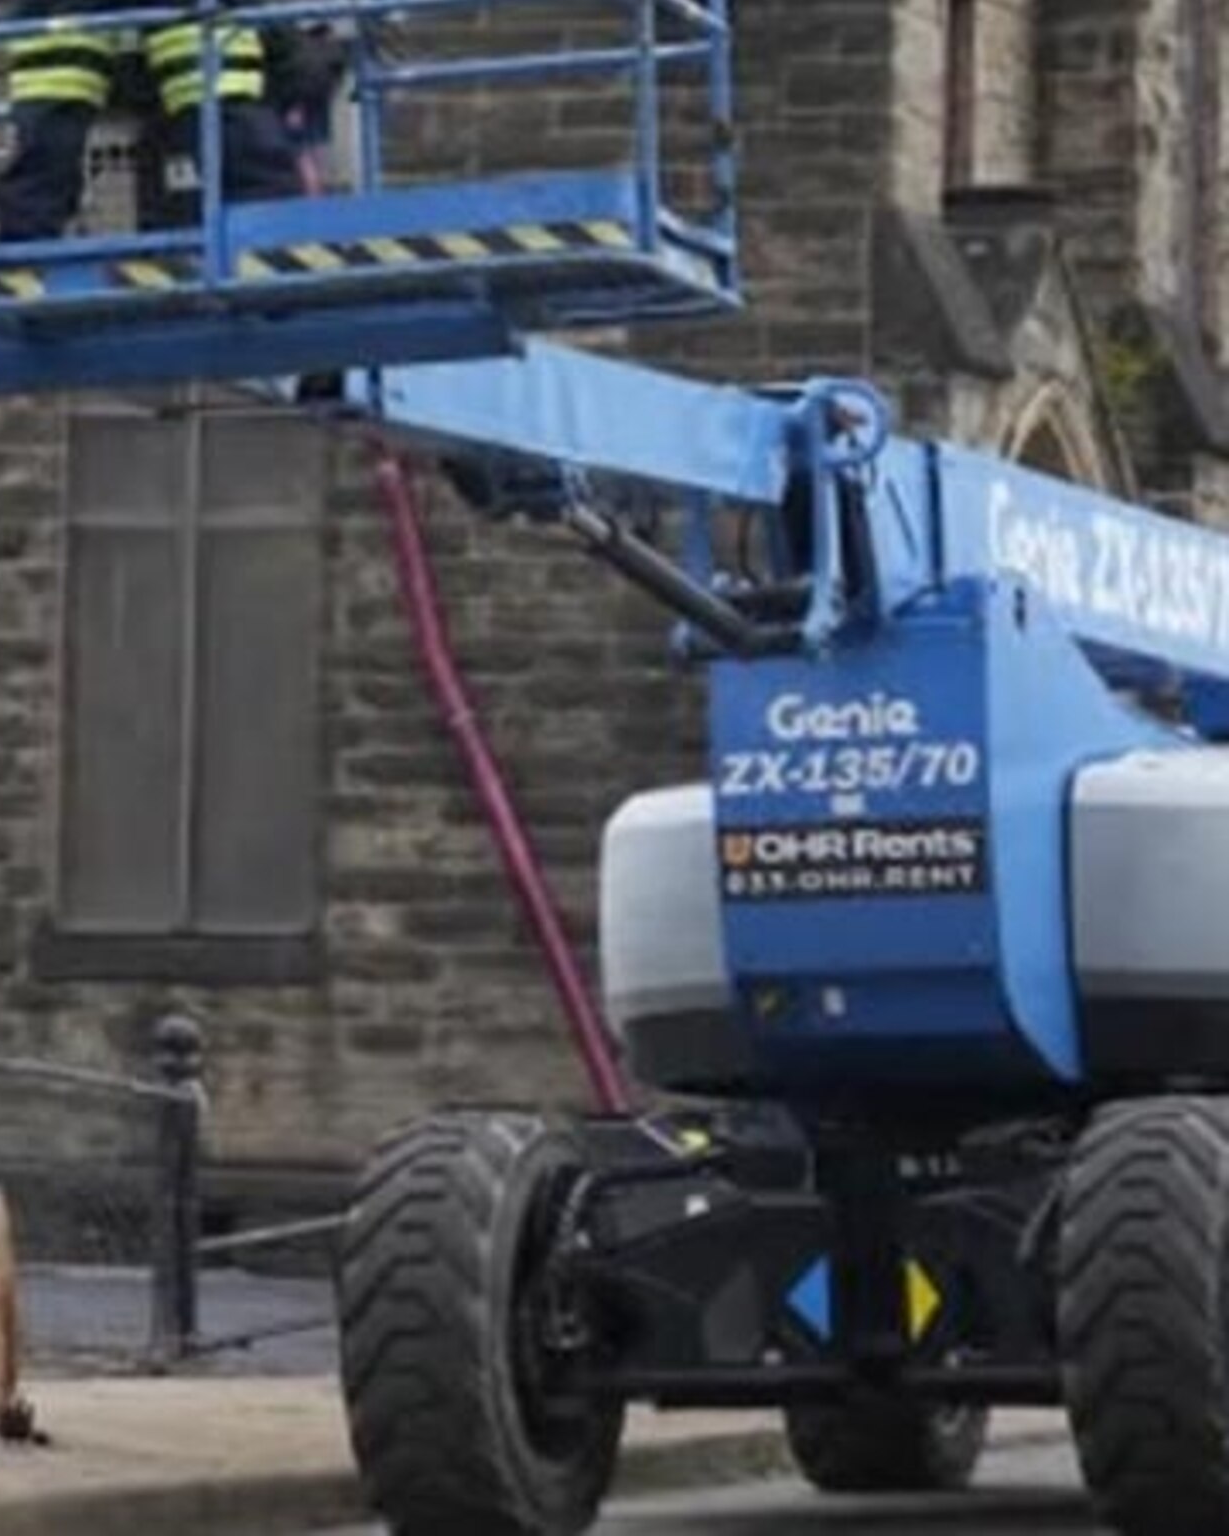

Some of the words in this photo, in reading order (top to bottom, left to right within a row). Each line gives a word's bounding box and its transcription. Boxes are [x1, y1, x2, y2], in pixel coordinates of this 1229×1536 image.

[767, 691, 919, 740] Genie
[721, 742, 978, 795] ZX-135/70
[852, 828, 976, 859] Rents
